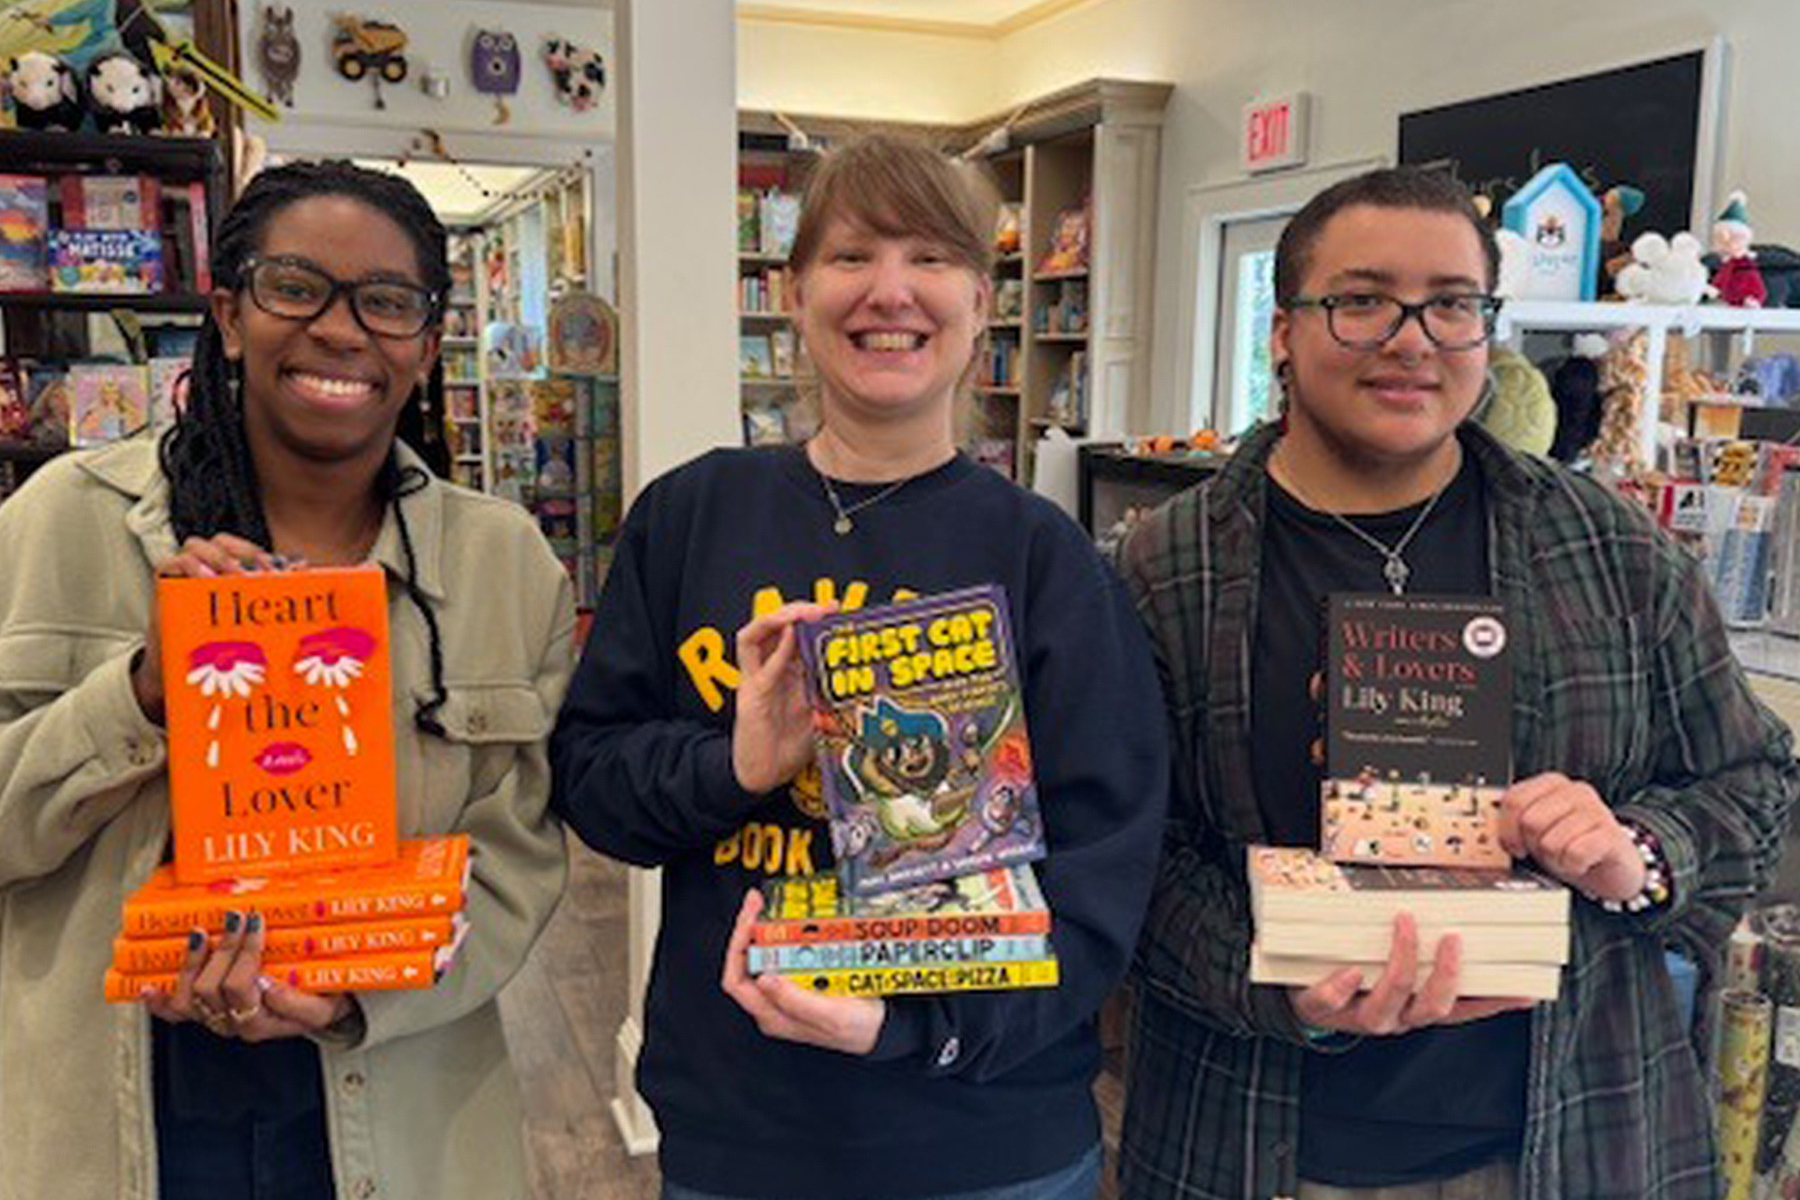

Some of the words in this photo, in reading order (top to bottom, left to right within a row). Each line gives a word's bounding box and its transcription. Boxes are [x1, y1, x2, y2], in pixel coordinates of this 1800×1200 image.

[1248, 104, 1289, 160] EXIT
[68, 243, 135, 258] MATISSE
[209, 590, 339, 628] Heart
[825, 624, 922, 668] FIRST
[927, 610, 993, 646] CAT
[1341, 620, 1460, 650] Writers
[831, 666, 876, 696] IN
[889, 639, 997, 686] SPACE
[1342, 651, 1363, 679] &
[1372, 654, 1476, 683] Lovers
[244, 694, 321, 732] the
[1342, 685, 1394, 714] Lily
[1400, 687, 1465, 717] King
[222, 777, 351, 818] Lover
[203, 830, 276, 862] LILY
[289, 822, 375, 855] KING
[331, 897, 369, 916] LILY
[375, 893, 425, 913] KING
[322, 933, 361, 953] LILY
[366, 929, 416, 948] KING
[854, 919, 919, 941] SOUP
[927, 916, 1000, 937] DOOM
[859, 939, 995, 963] PAPERCLIP
[304, 968, 341, 987] LILY
[347, 966, 397, 984] KING
[849, 972, 885, 992] CAT
[890, 969, 949, 990] SPACE
[956, 966, 1011, 986] PIZZA
